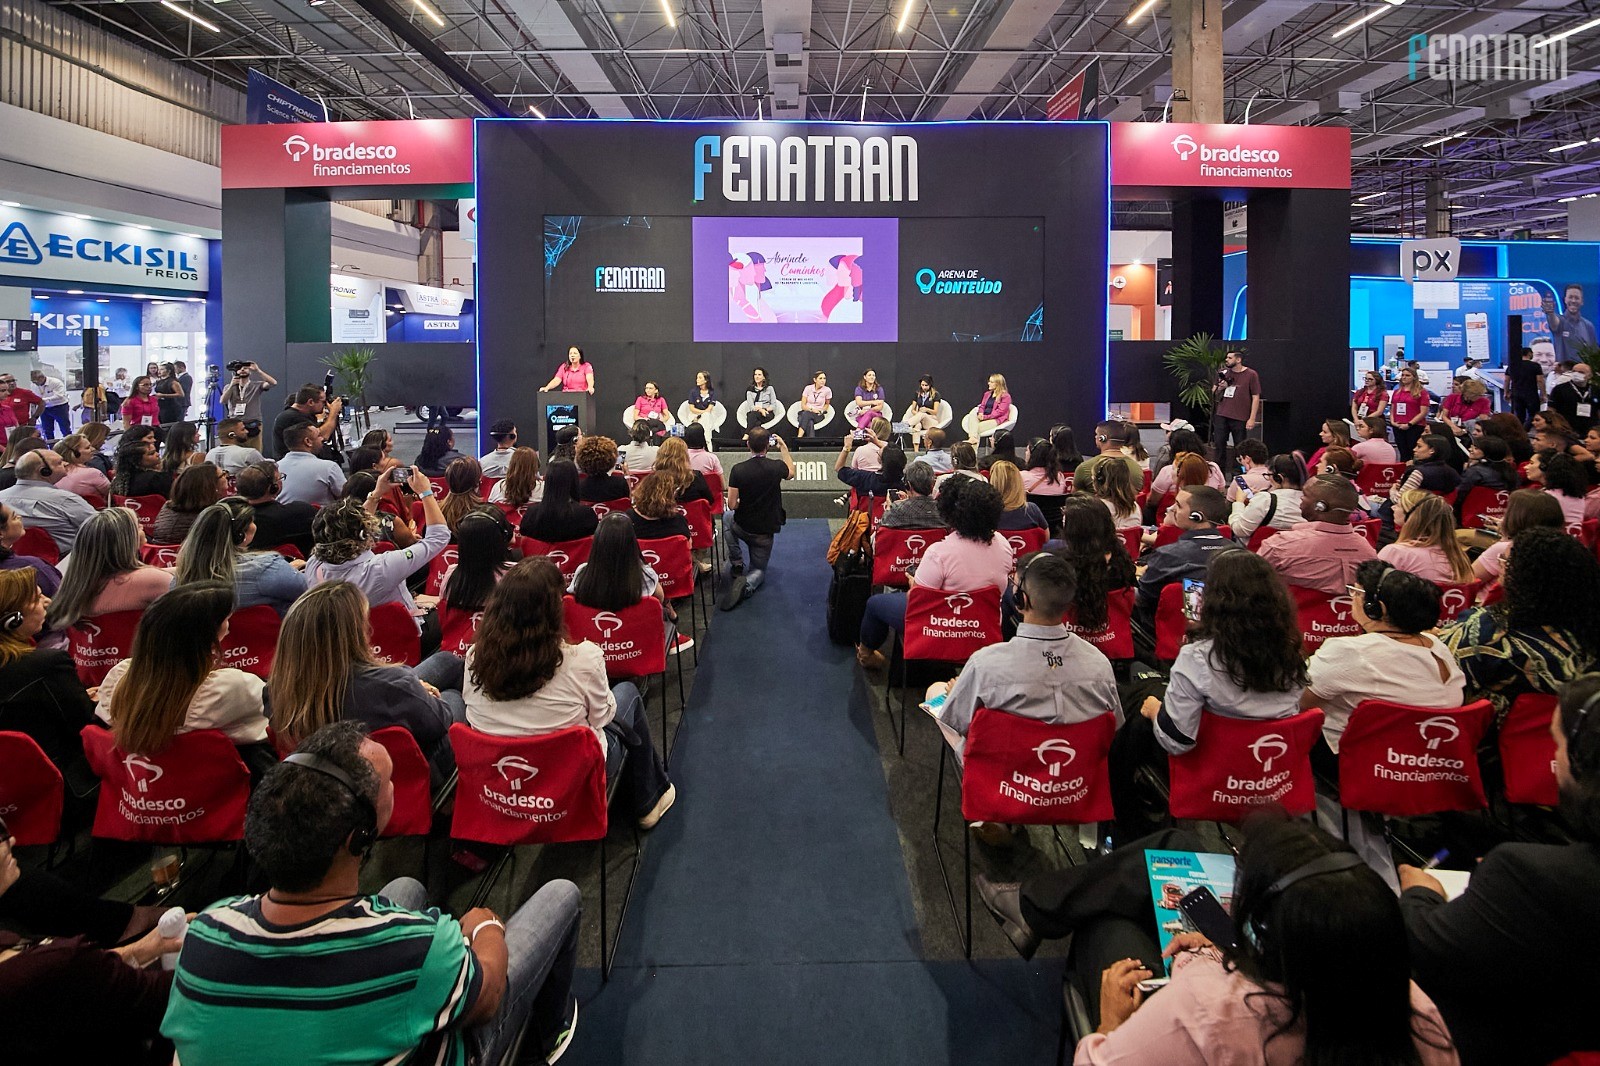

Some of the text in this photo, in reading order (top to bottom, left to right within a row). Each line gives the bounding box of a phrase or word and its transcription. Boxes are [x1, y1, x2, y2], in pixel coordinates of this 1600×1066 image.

[267, 93, 318, 121] CHIPTRONIC
[313, 142, 397, 160] bradesco
[1200, 144, 1280, 162] bradesco
[314, 164, 411, 176] financiamentos
[694, 135, 918, 201] FENATRAN
[1200, 164, 1292, 177] financiamentos
[43, 234, 197, 272] ECKISIL
[938, 270, 978, 278] ARENA DE
[1413, 250, 1452, 278] px
[146, 268, 198, 281] FREIOS
[596, 267, 665, 288] FENATRAN
[935, 278, 1002, 294] CONTEÚDO
[418, 294, 439, 303] ASTRA
[32, 312, 109, 330] KISIL
[896, 556, 922, 565] brade
[930, 614, 980, 628] bradesco
[922, 626, 986, 639] financiamentos
[1387, 748, 1464, 769] bradesco
[1013, 771, 1084, 794] bradesco
[1227, 770, 1290, 790] bradesco
[1374, 764, 1469, 782] financiamentos
[122, 787, 186, 811] bradesco
[484, 785, 554, 809] bradesco
[999, 781, 1088, 807] financiamentos
[1212, 781, 1293, 804] financiamentos
[119, 800, 205, 825] financiamentos
[479, 793, 567, 823] financiamentos
